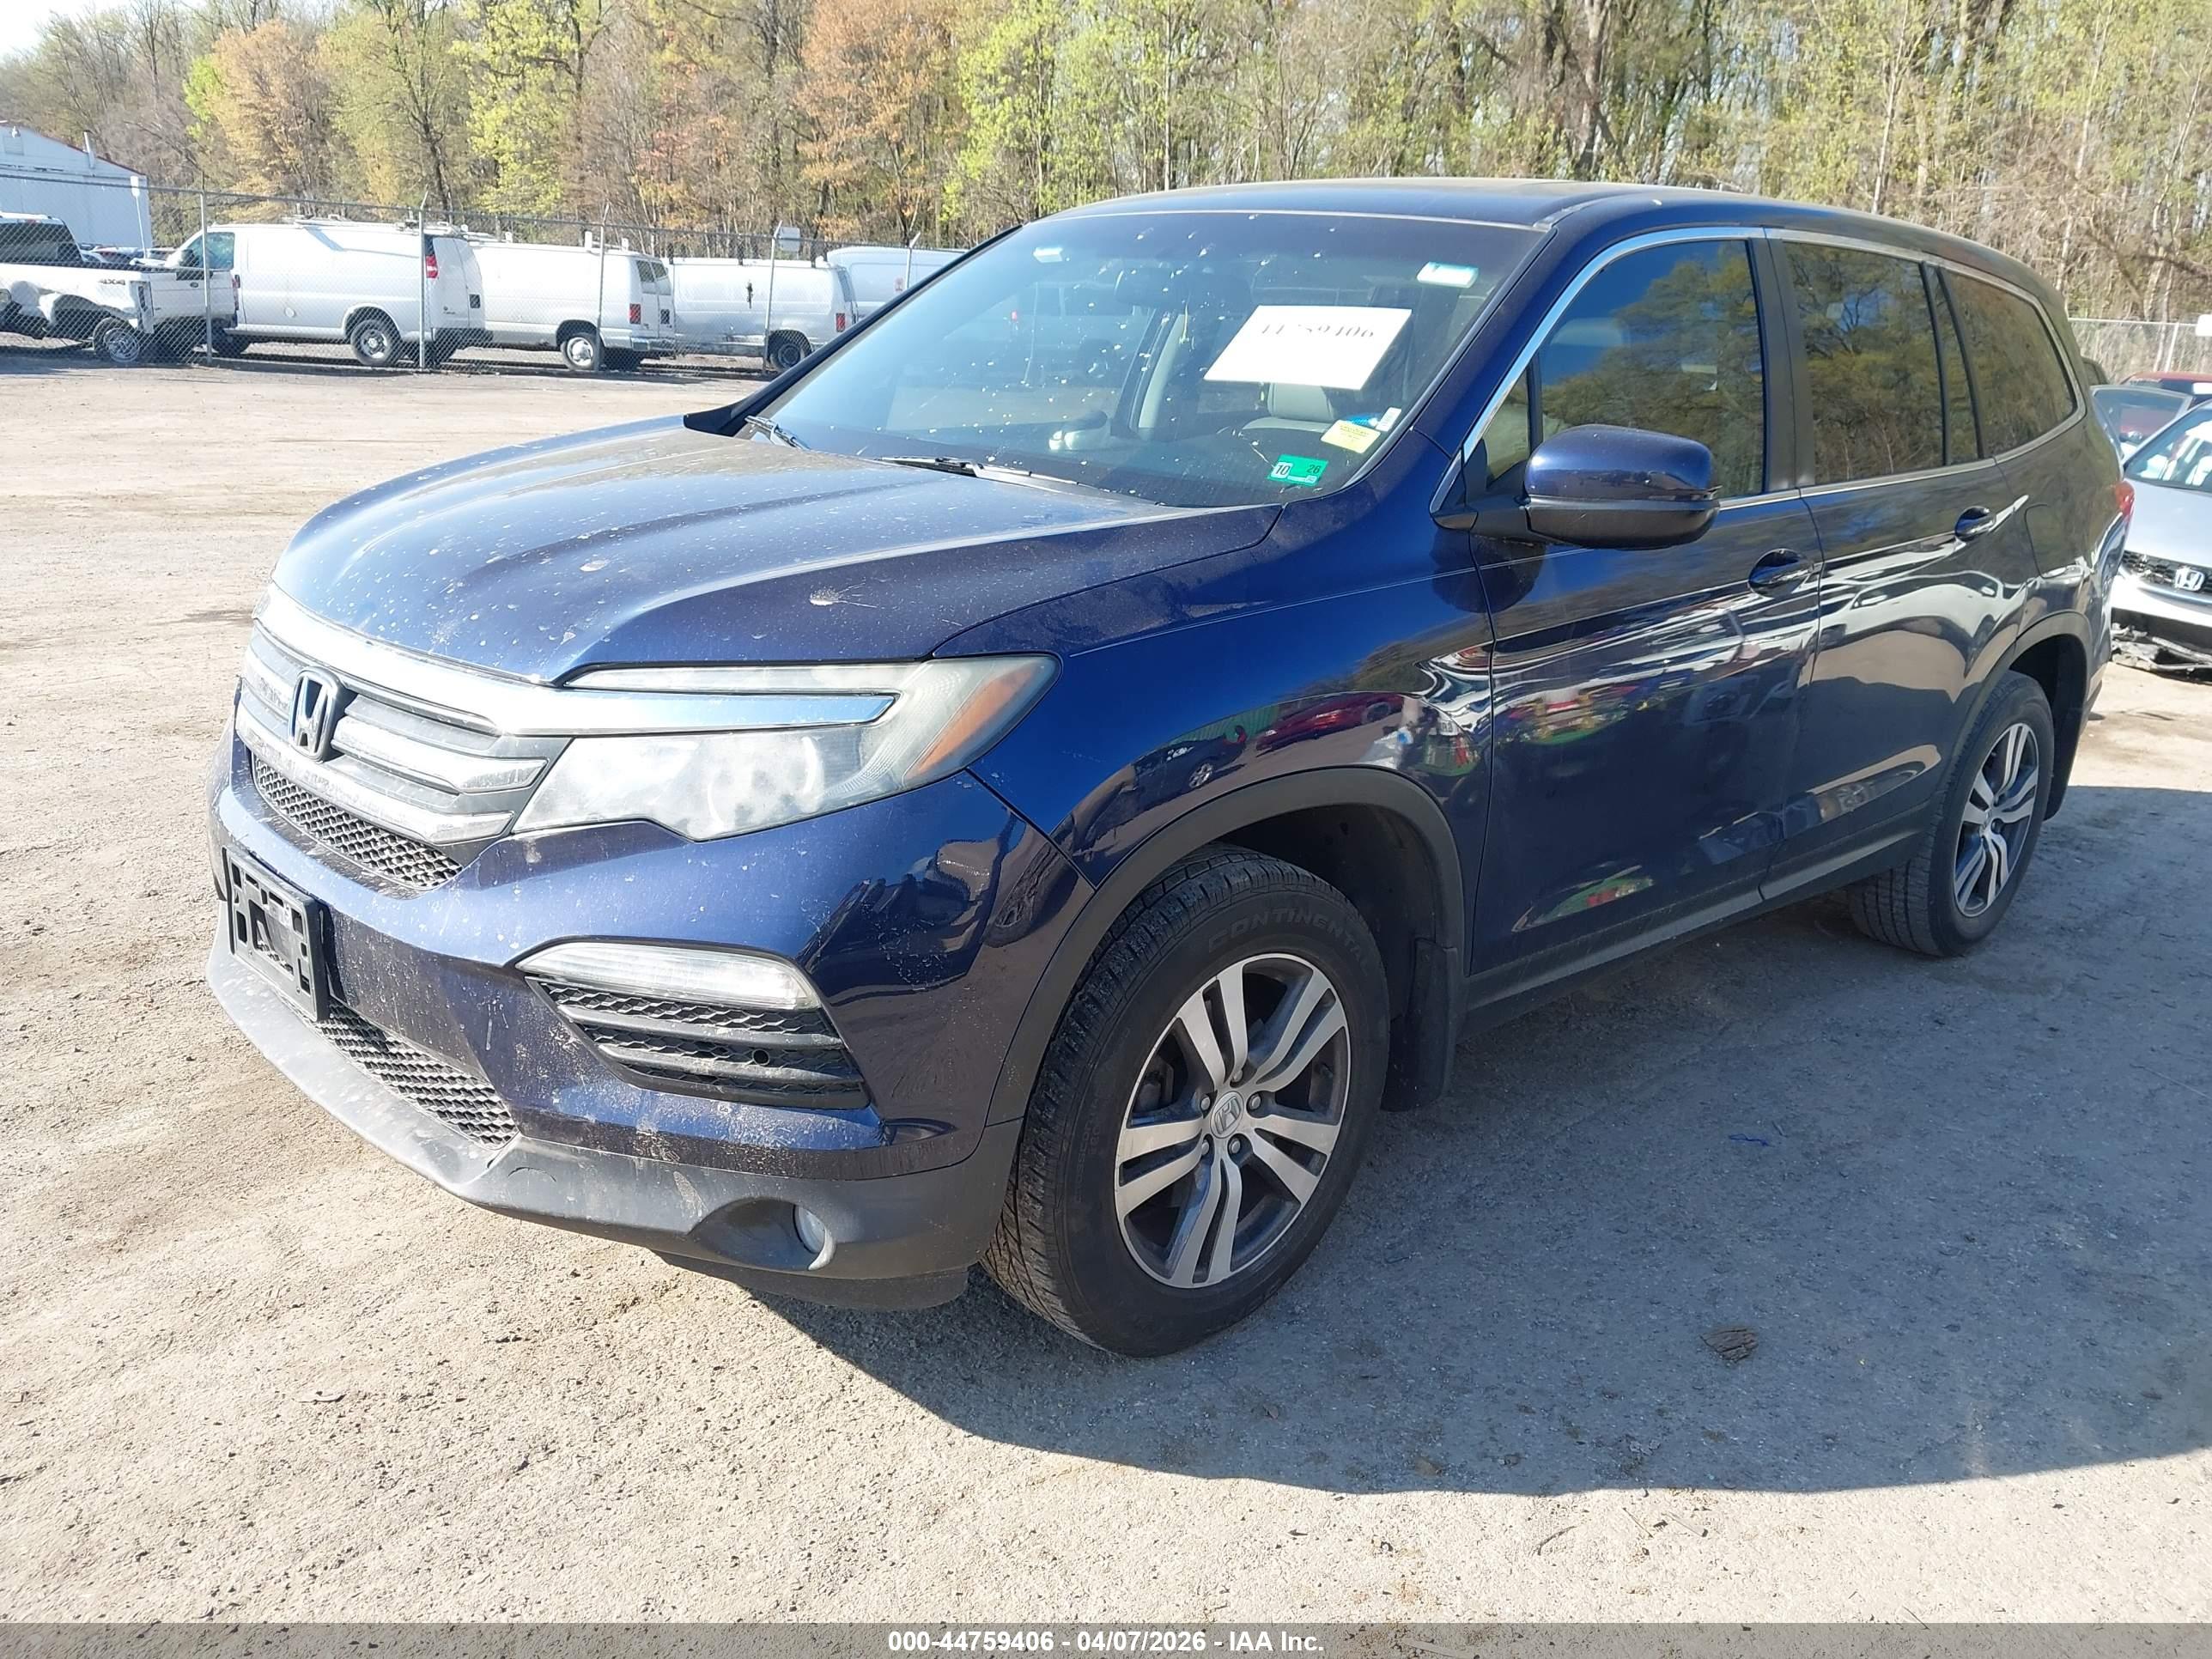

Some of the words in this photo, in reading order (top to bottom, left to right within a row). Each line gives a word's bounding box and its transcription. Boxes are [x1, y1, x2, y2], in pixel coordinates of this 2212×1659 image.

[1275, 464, 1291, 476] 10
[1307, 465, 1322, 474] 26
[1209, 908, 1368, 976] CONTINENTAL
